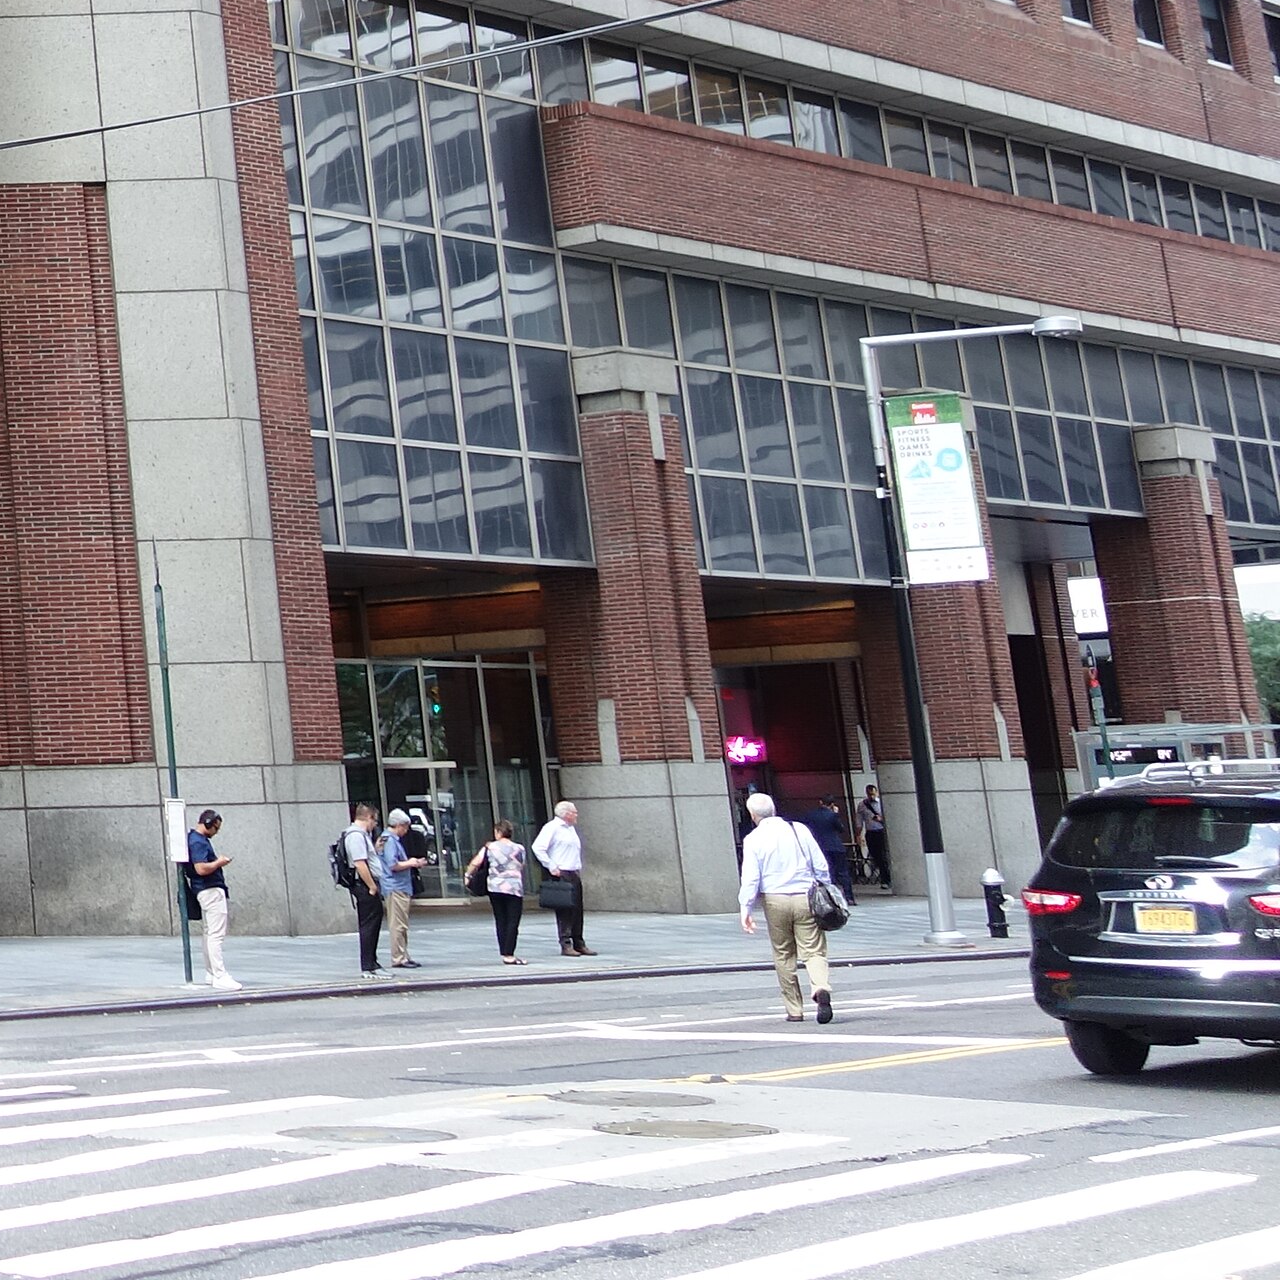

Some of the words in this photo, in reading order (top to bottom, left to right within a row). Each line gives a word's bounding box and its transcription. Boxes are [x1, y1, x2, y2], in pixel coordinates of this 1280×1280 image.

[897, 428, 930, 437] SPORTS
[899, 443, 930, 451] GAMES
[900, 450, 932, 458] DRINKS
